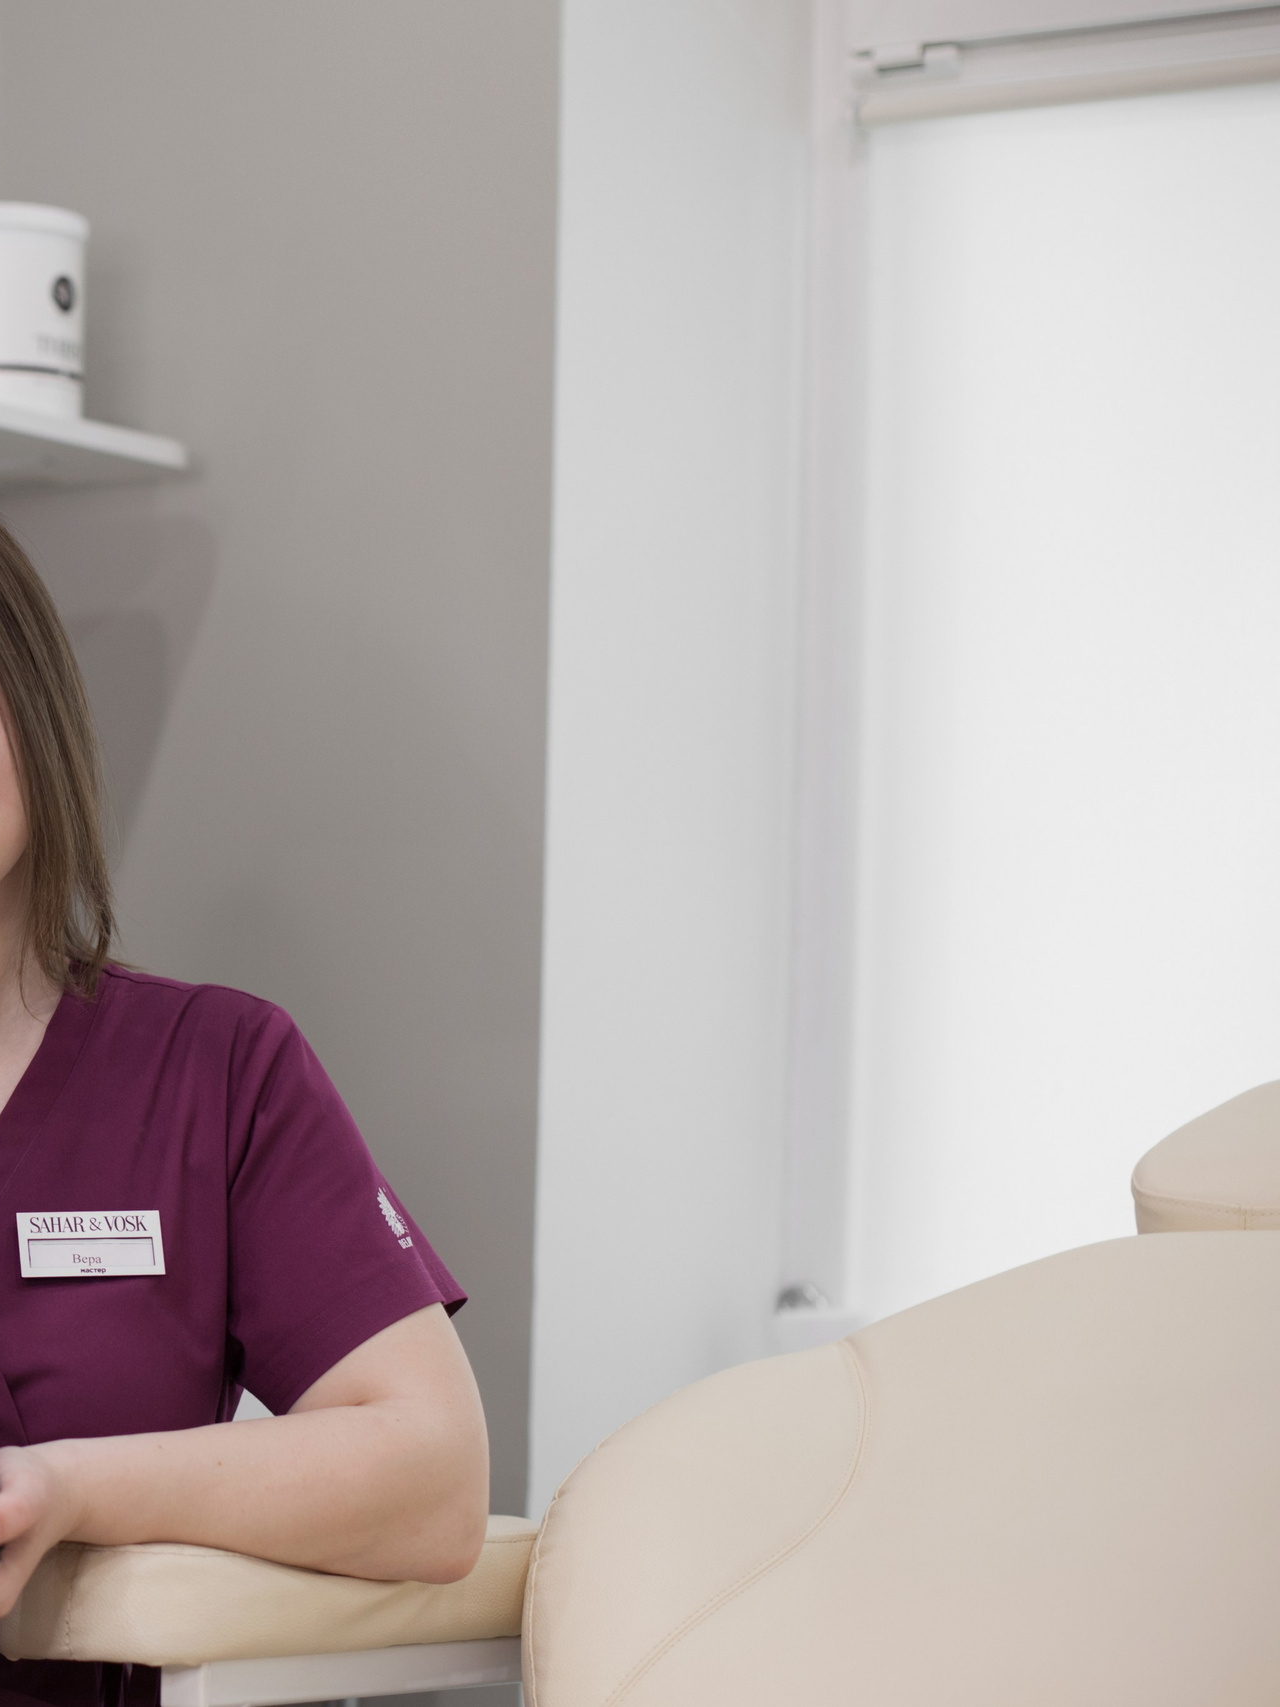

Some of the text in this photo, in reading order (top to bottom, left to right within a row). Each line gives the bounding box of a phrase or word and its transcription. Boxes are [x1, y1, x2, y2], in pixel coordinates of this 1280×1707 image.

[30, 1215, 148, 1233] SAHAR & VOSK
[72, 1253, 102, 1266] Вера
